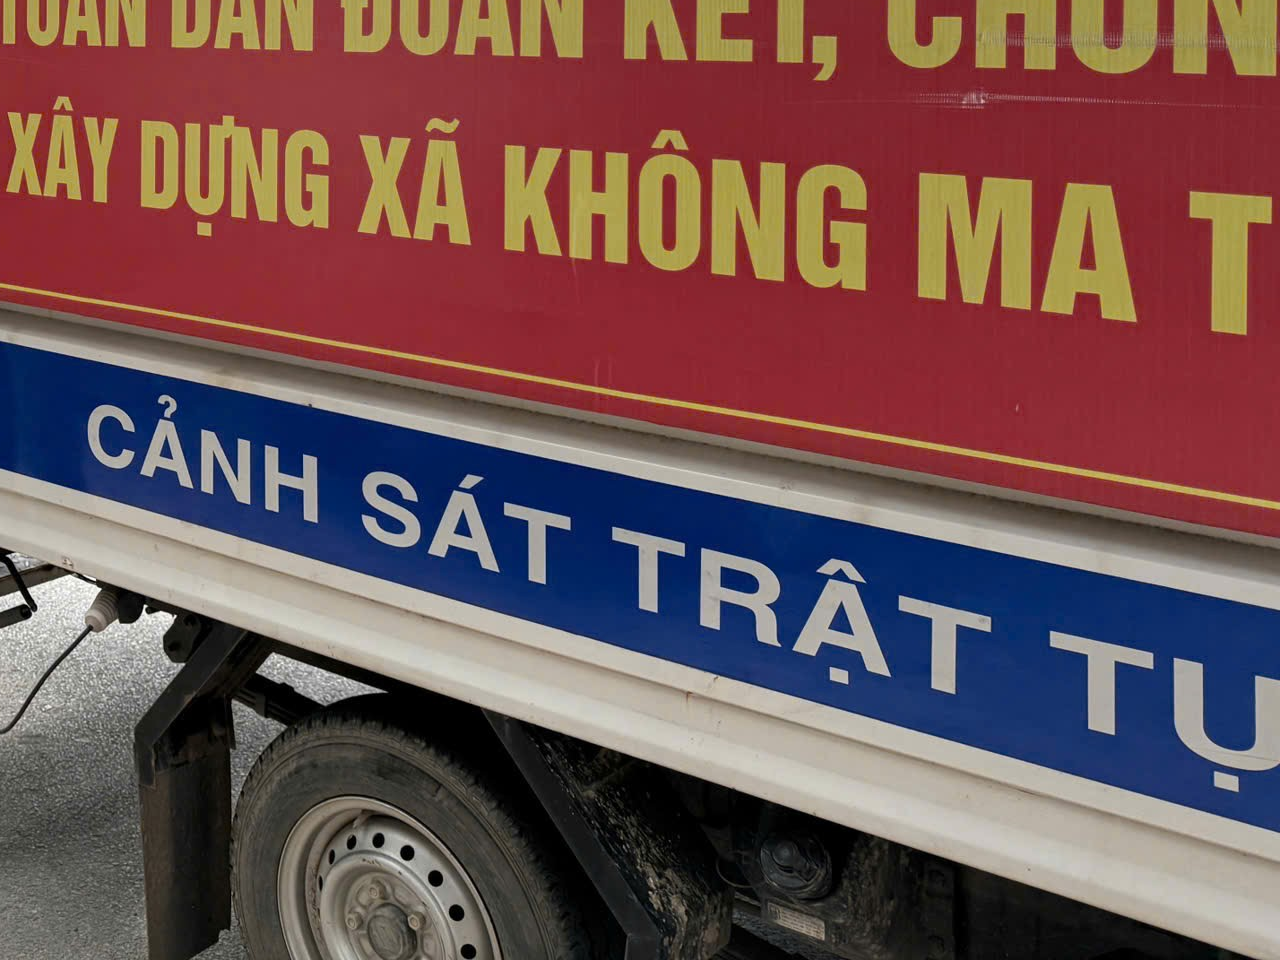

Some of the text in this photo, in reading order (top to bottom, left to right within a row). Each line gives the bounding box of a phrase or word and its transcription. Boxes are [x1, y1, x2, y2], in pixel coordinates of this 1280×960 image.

[6, 96, 1273, 336] XÂY DỰNG XÃ KHÔNG MA T
[87, 394, 319, 523] CẢNH
[361, 471, 572, 585] SÁT
[611, 526, 992, 695] TRẬT
